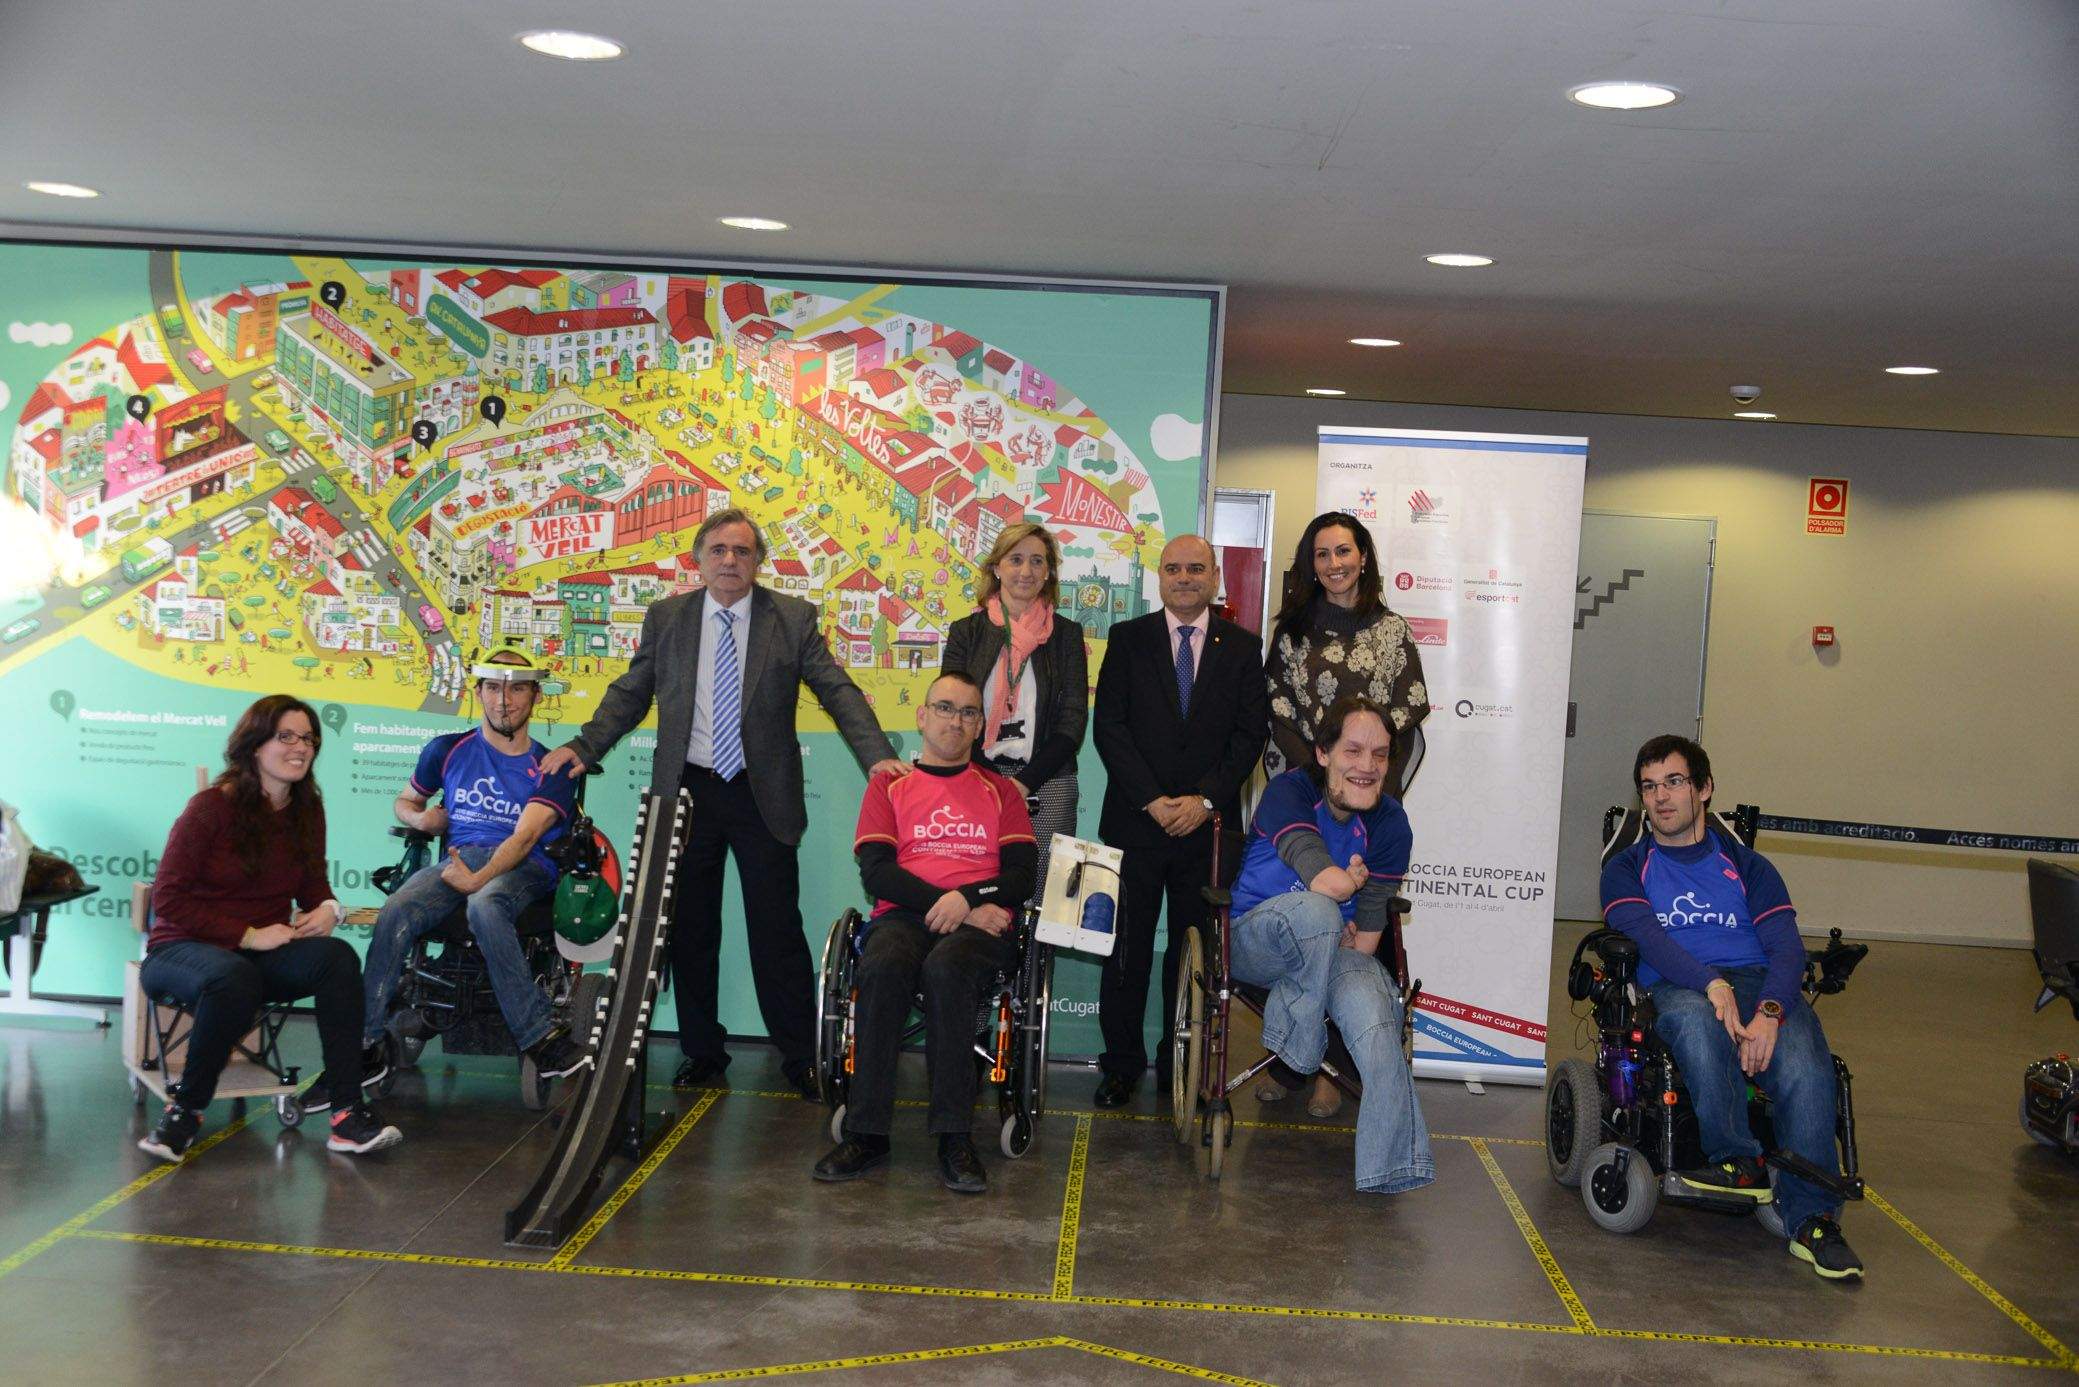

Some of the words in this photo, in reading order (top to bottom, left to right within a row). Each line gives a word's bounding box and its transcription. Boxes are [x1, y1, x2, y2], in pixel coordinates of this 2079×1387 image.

[328, 288, 337, 301] 2
[132, 402, 144, 414] 4
[488, 402, 496, 415] 1
[419, 426, 429, 439] 3
[840, 399, 890, 465] Voltes
[1330, 462, 1373, 470] ORGANITZA
[1055, 476, 1127, 531] MONESTIR
[529, 514, 604, 544] MERCAT
[1808, 519, 1844, 527] POLSADOR
[536, 536, 596, 560] VELL
[1416, 575, 1453, 584] Diputació
[1416, 583, 1452, 591] Barcelona
[80, 708, 149, 723] Remodelem
[150, 711, 162, 724] el
[163, 712, 203, 726] Mercat
[204, 714, 227, 727] Vell
[328, 710, 339, 722] 2
[353, 722, 378, 734] Fem
[379, 723, 435, 739] habitatge
[353, 742, 421, 755] aparcament
[455, 788, 521, 815] BOCCIA
[913, 822, 988, 840] BOCCIA
[1463, 866, 1545, 883] EUROPEAN
[1504, 885, 1544, 901] CUP
[1656, 910, 1738, 929] BOCCIA
[1416, 996, 1438, 1008] SANT
[1439, 1003, 1467, 1016] CUGAT
[1471, 1011, 1494, 1023] SANT
[1495, 1018, 1522, 1031] CUGAT
[1426, 1024, 1453, 1040] BOCCIA
[1065, 1340, 1127, 1357] FECPC
[1136, 1355, 1199, 1375] FECPC
